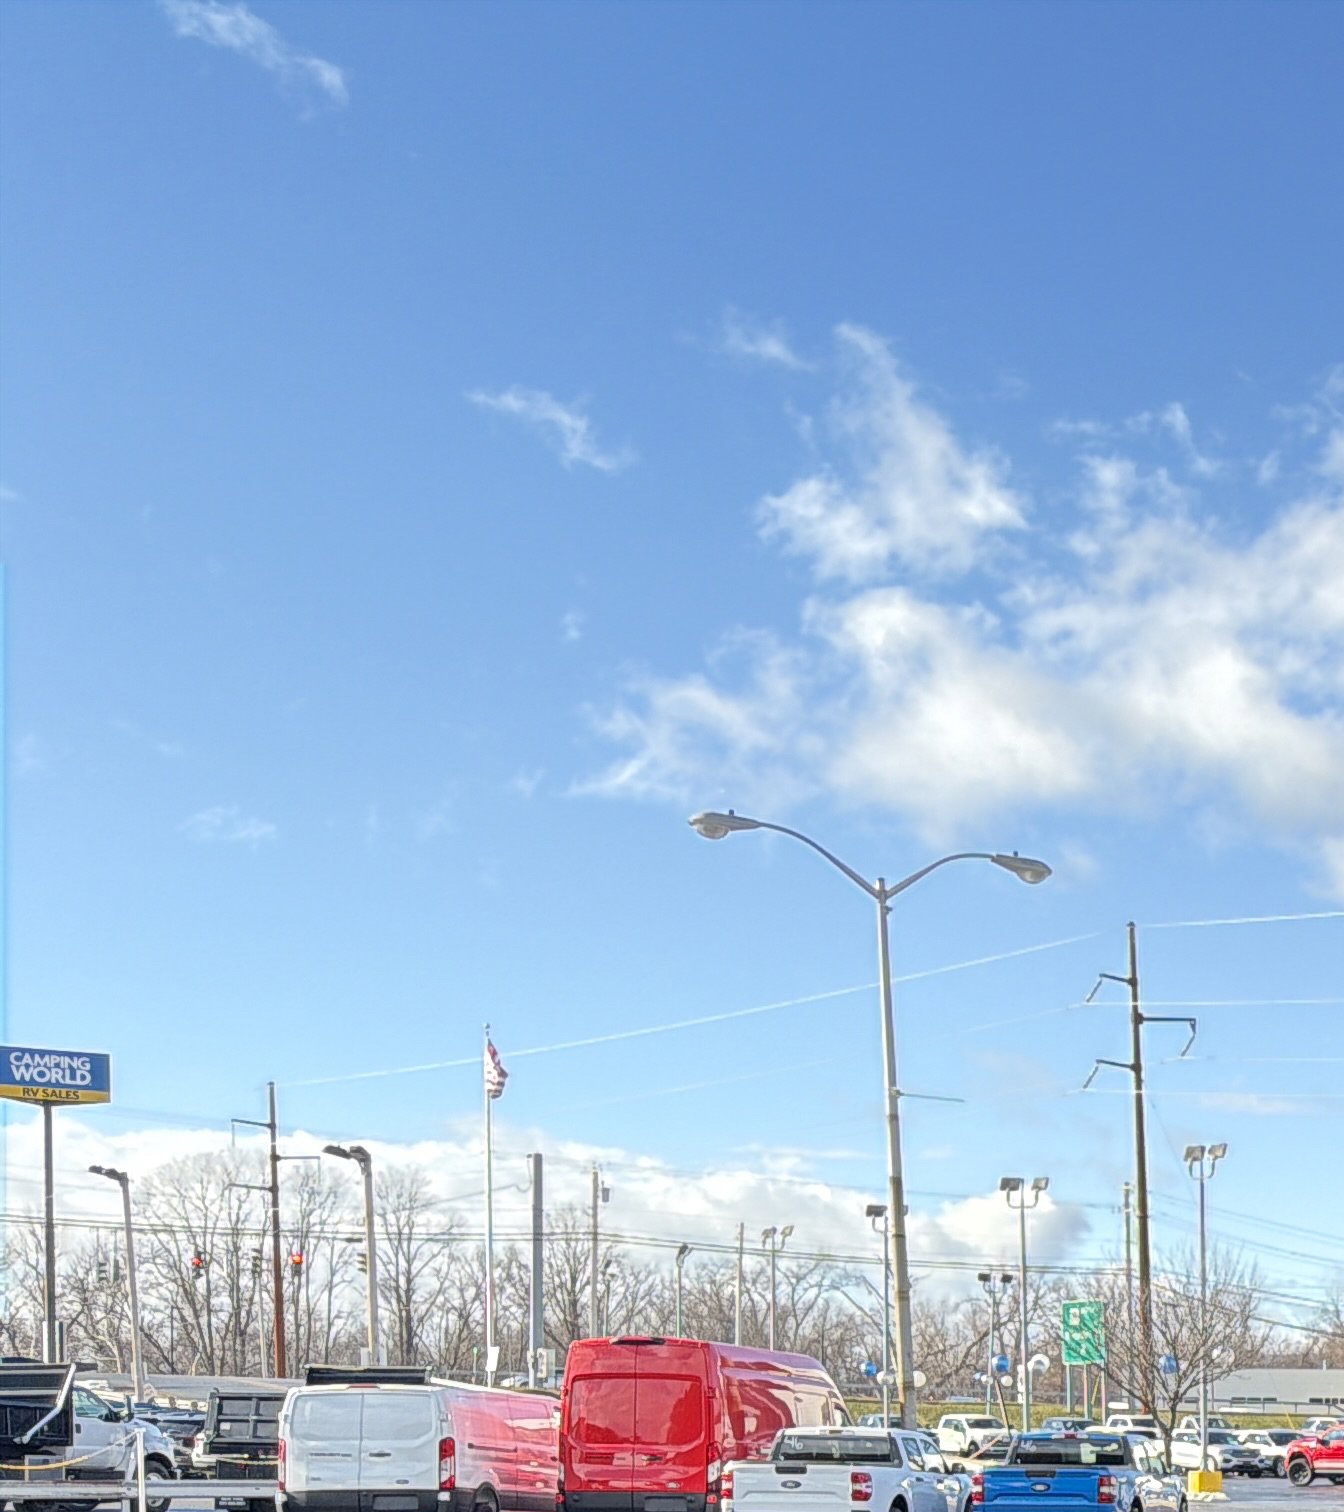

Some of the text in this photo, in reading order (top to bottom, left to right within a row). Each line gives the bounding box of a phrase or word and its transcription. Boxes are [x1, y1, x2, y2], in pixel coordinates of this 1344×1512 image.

[9, 1051, 91, 1071] CAMPING
[10, 1064, 92, 1086] WORLD
[22, 1087, 80, 1100] RV SALES
[784, 1436, 804, 1450] 46
